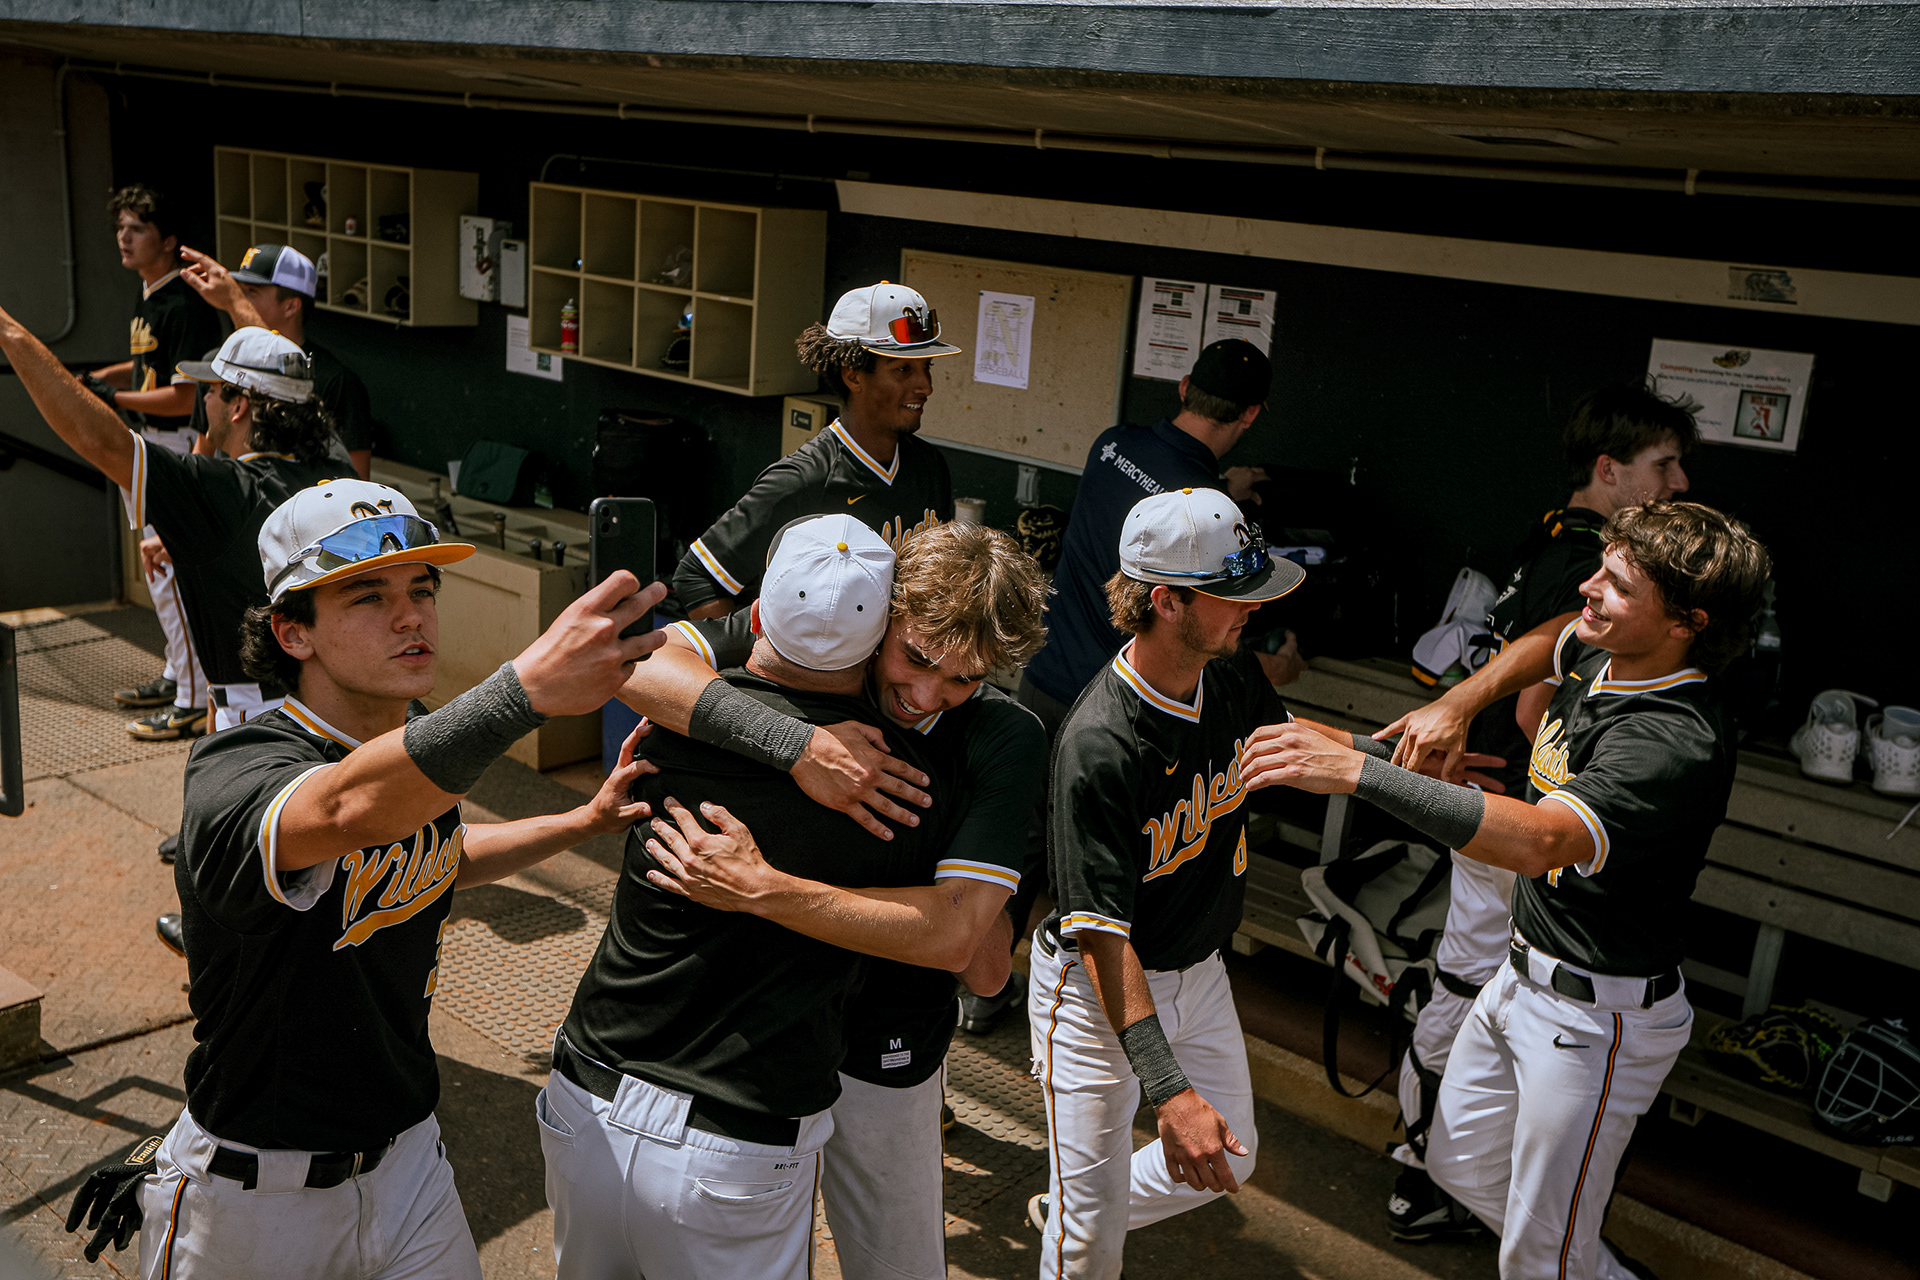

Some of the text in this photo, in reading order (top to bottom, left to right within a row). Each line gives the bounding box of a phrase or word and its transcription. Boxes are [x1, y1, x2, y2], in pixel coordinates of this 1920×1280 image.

[889, 1038, 902, 1050] M
[131, 1138, 163, 1163] Franklin
[774, 1162, 799, 1170] DRI-FIT
